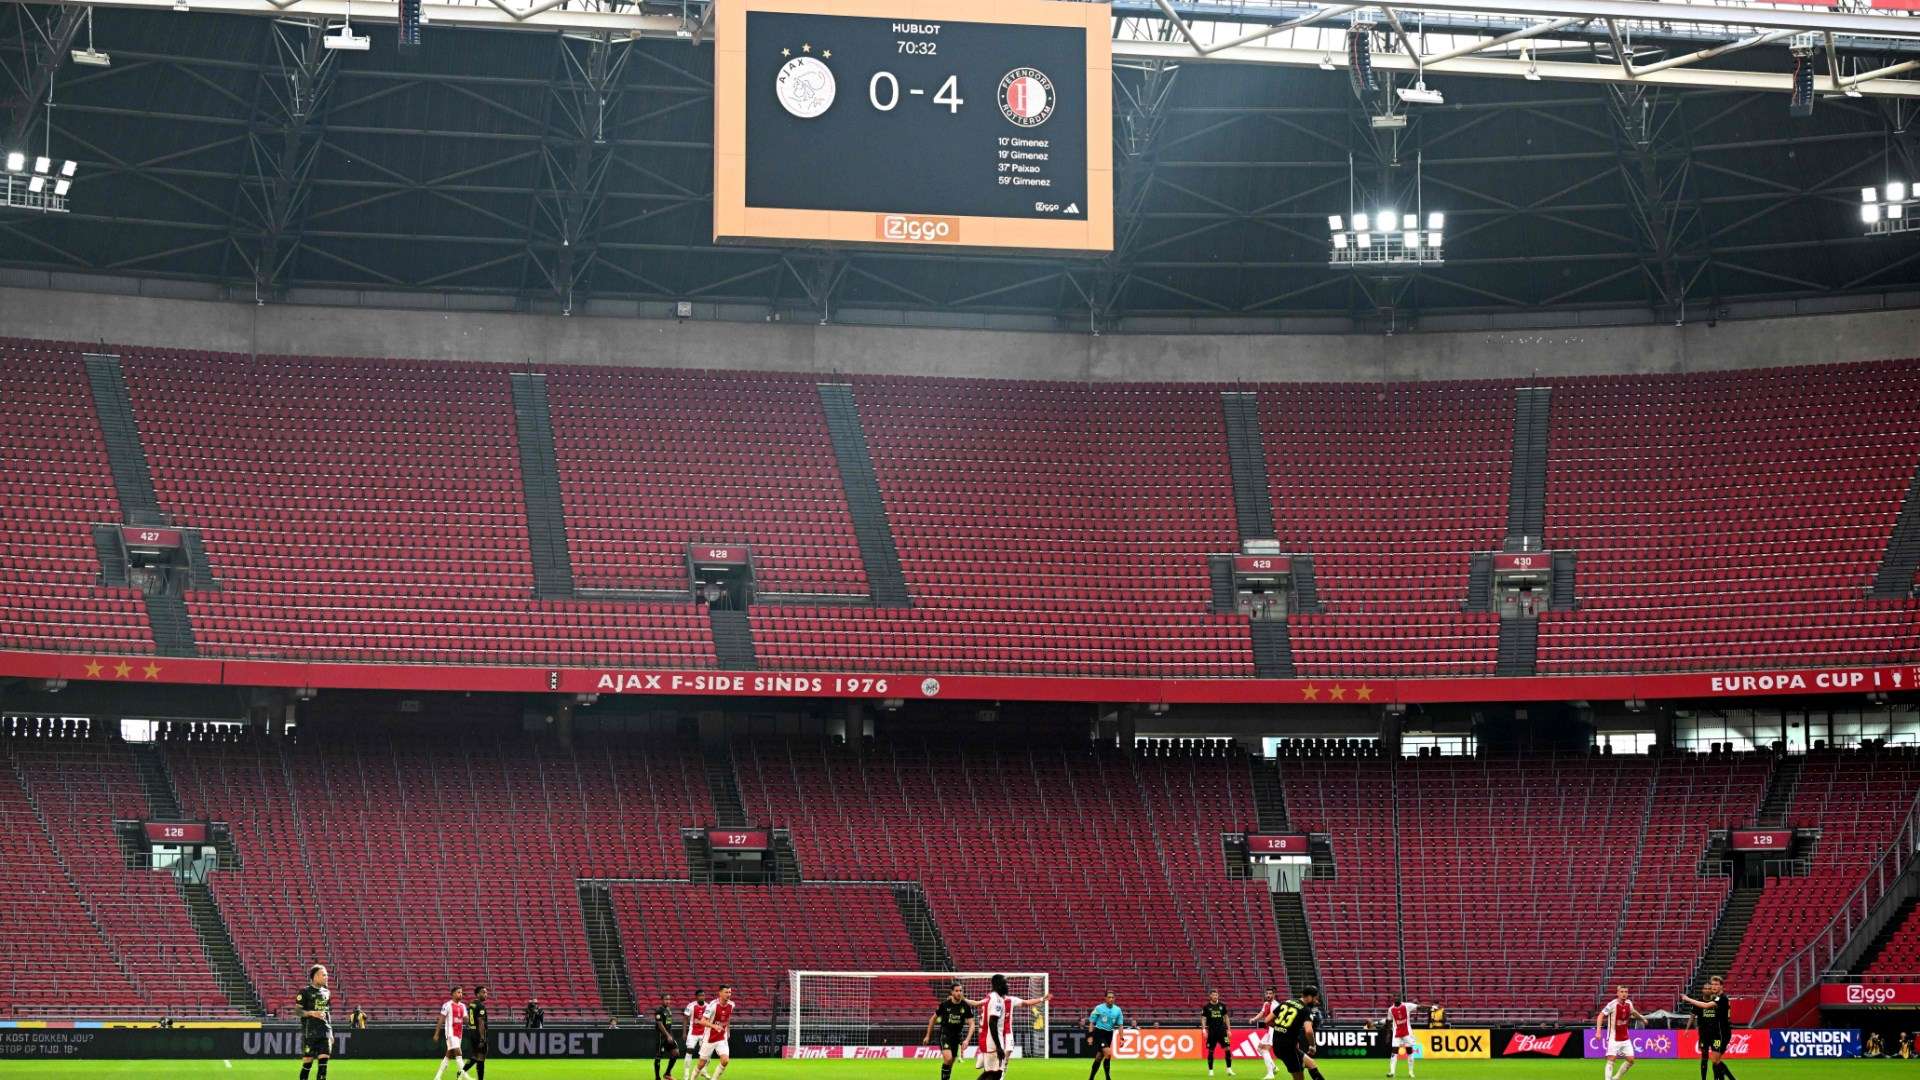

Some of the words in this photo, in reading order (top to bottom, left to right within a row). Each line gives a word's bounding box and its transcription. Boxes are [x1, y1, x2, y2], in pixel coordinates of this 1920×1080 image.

[892, 23, 941, 35] HUBLOT
[897, 41, 937, 55] 70:32
[779, 58, 805, 85] AJAX
[1002, 70, 1051, 90] FEYENOORD
[869, 71, 899, 111] 0
[933, 75, 964, 113] 4
[1002, 103, 1052, 125] ROTTERDAM
[1011, 137, 1049, 148] Gimenez
[1010, 150, 1049, 160] Gimenez
[1011, 163, 1041, 173] Paixao
[1012, 176, 1051, 187] Gimenez
[140, 531, 160, 541] 427
[709, 549, 728, 559] 428
[1513, 557, 1532, 566] 430
[597, 673, 662, 693] AJAX
[671, 675, 745, 690] F-SIDE
[754, 676, 823, 692] SINDS
[834, 677, 888, 693] 1976
[1711, 674, 1806, 691] EUROPA
[1815, 671, 1864, 688] CUP
[728, 834, 747, 844] 127
[1753, 835, 1773, 845] 129
[5, 1033, 29, 1043] KOST
[32, 1033, 68, 1043] GOKKEN
[1315, 1031, 1379, 1047] UNIBET
[1514, 1032, 1554, 1051] Bud
[1780, 1030, 1851, 1043] VRIENDEN
[498, 1032, 604, 1055] UNIBET
[1431, 1036, 1483, 1053] BLOX
[914, 1047, 943, 1059] Flin
[1789, 1043, 1843, 1058] LOTERIJ
